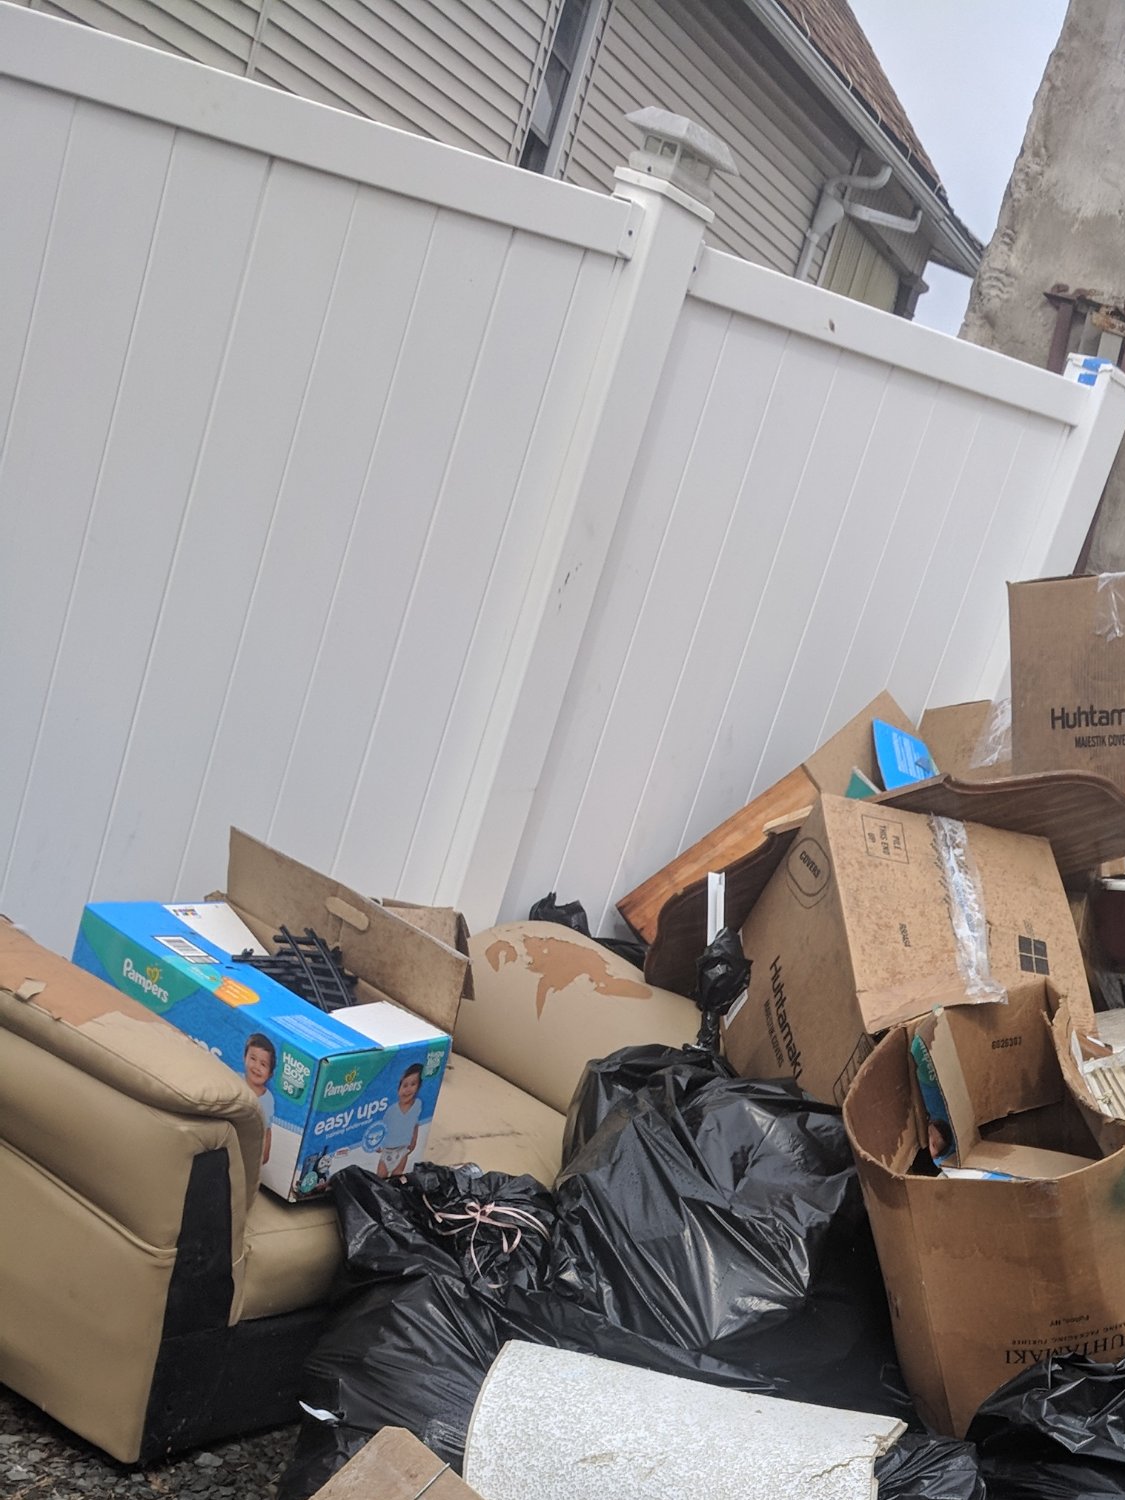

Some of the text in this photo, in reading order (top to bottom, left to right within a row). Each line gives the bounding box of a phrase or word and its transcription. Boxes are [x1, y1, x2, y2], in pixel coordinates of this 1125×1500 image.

[1074, 735, 1107, 749] MAJESTIK
[799, 850, 821, 879] COVERS
[122, 957, 169, 1004] Pampers
[769, 955, 803, 1079] Huhtamaki
[282, 1051, 311, 1077] Huge
[283, 1063, 305, 1084] Box
[282, 1080, 294, 1095] 96
[323, 1079, 363, 1099] Pampers
[313, 1097, 389, 1136] easy ups
[1011, 1338, 1048, 1346] FURTHER
[1051, 1328, 1100, 1342] PACKAGING
